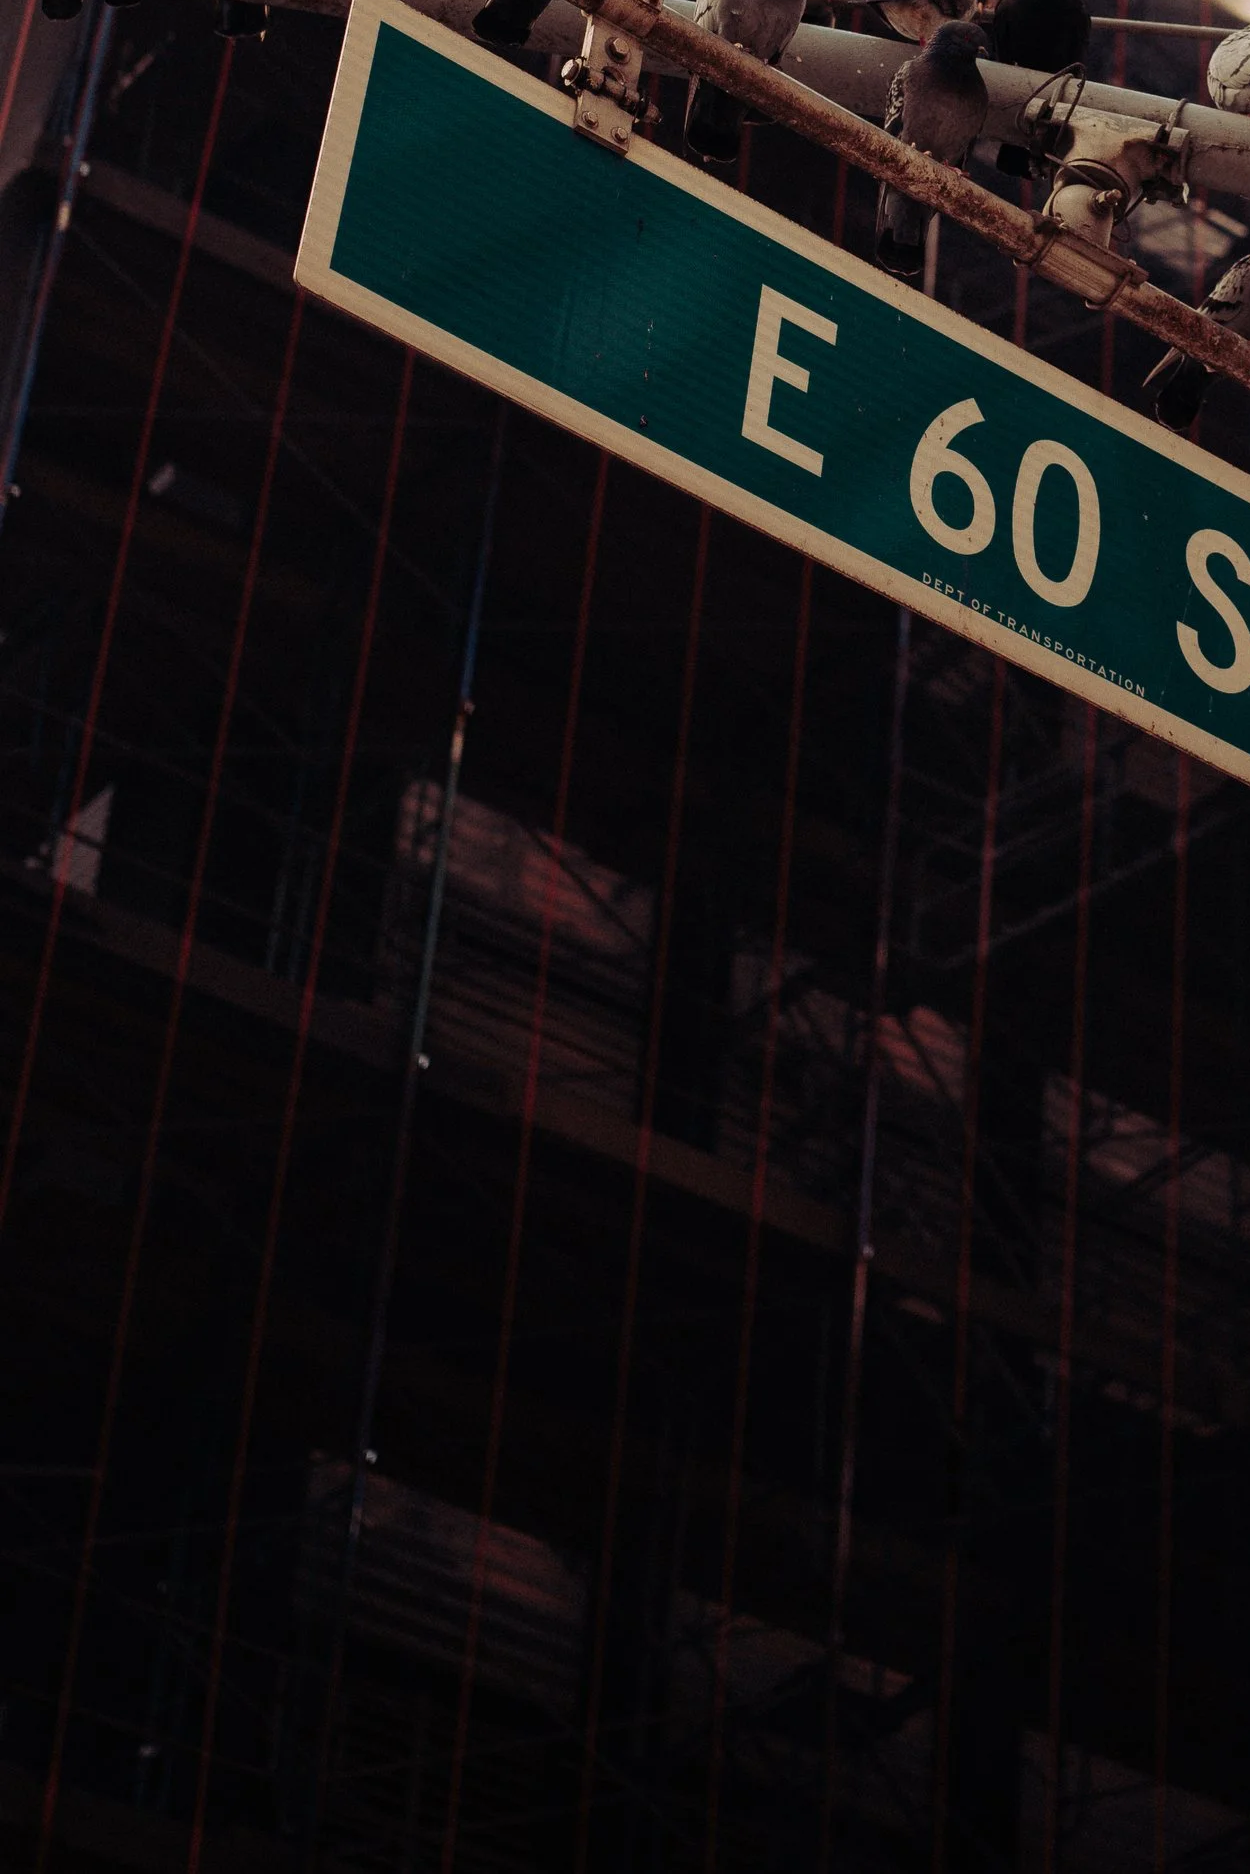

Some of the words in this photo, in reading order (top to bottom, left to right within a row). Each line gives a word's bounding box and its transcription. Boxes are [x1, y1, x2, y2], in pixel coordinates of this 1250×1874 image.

[741, 283, 839, 478] E
[909, 397, 1101, 608] 60
[921, 572, 965, 602] DEPT
[971, 598, 992, 615] OF
[997, 611, 1147, 698] TRANSPORTATION
